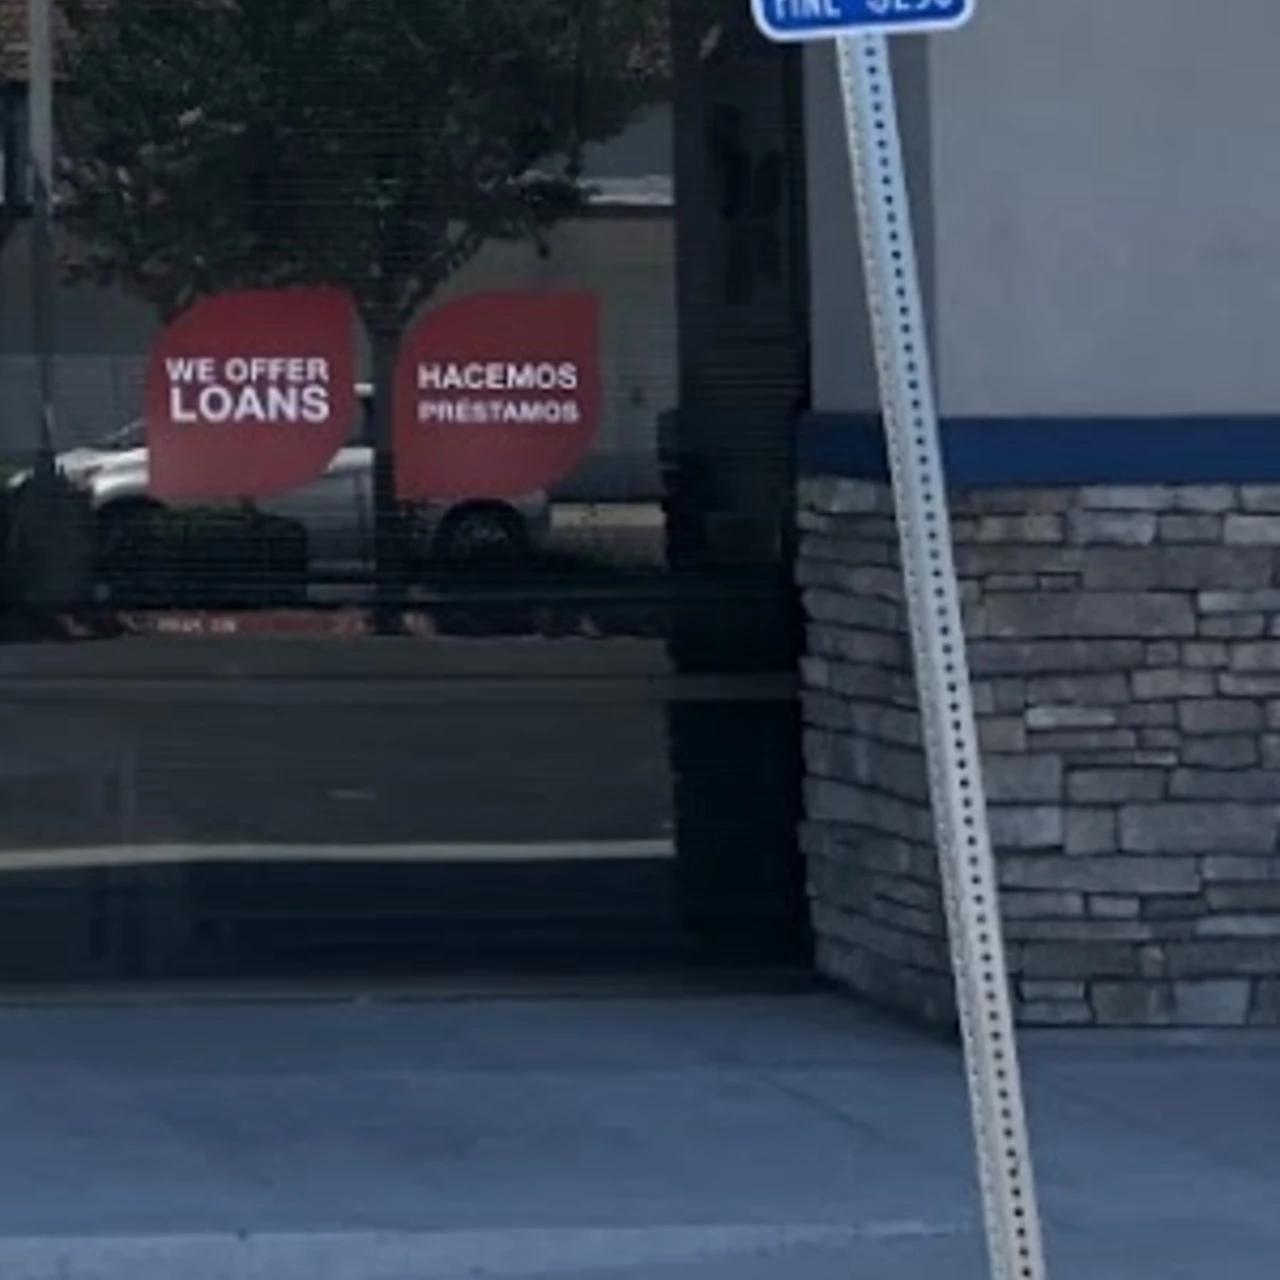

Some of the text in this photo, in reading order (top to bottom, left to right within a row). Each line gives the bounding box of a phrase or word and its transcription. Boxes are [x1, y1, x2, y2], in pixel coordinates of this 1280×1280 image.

[166, 358, 329, 383] WE OFFER
[418, 363, 577, 389] HACEMOS
[170, 385, 329, 422] LOANS
